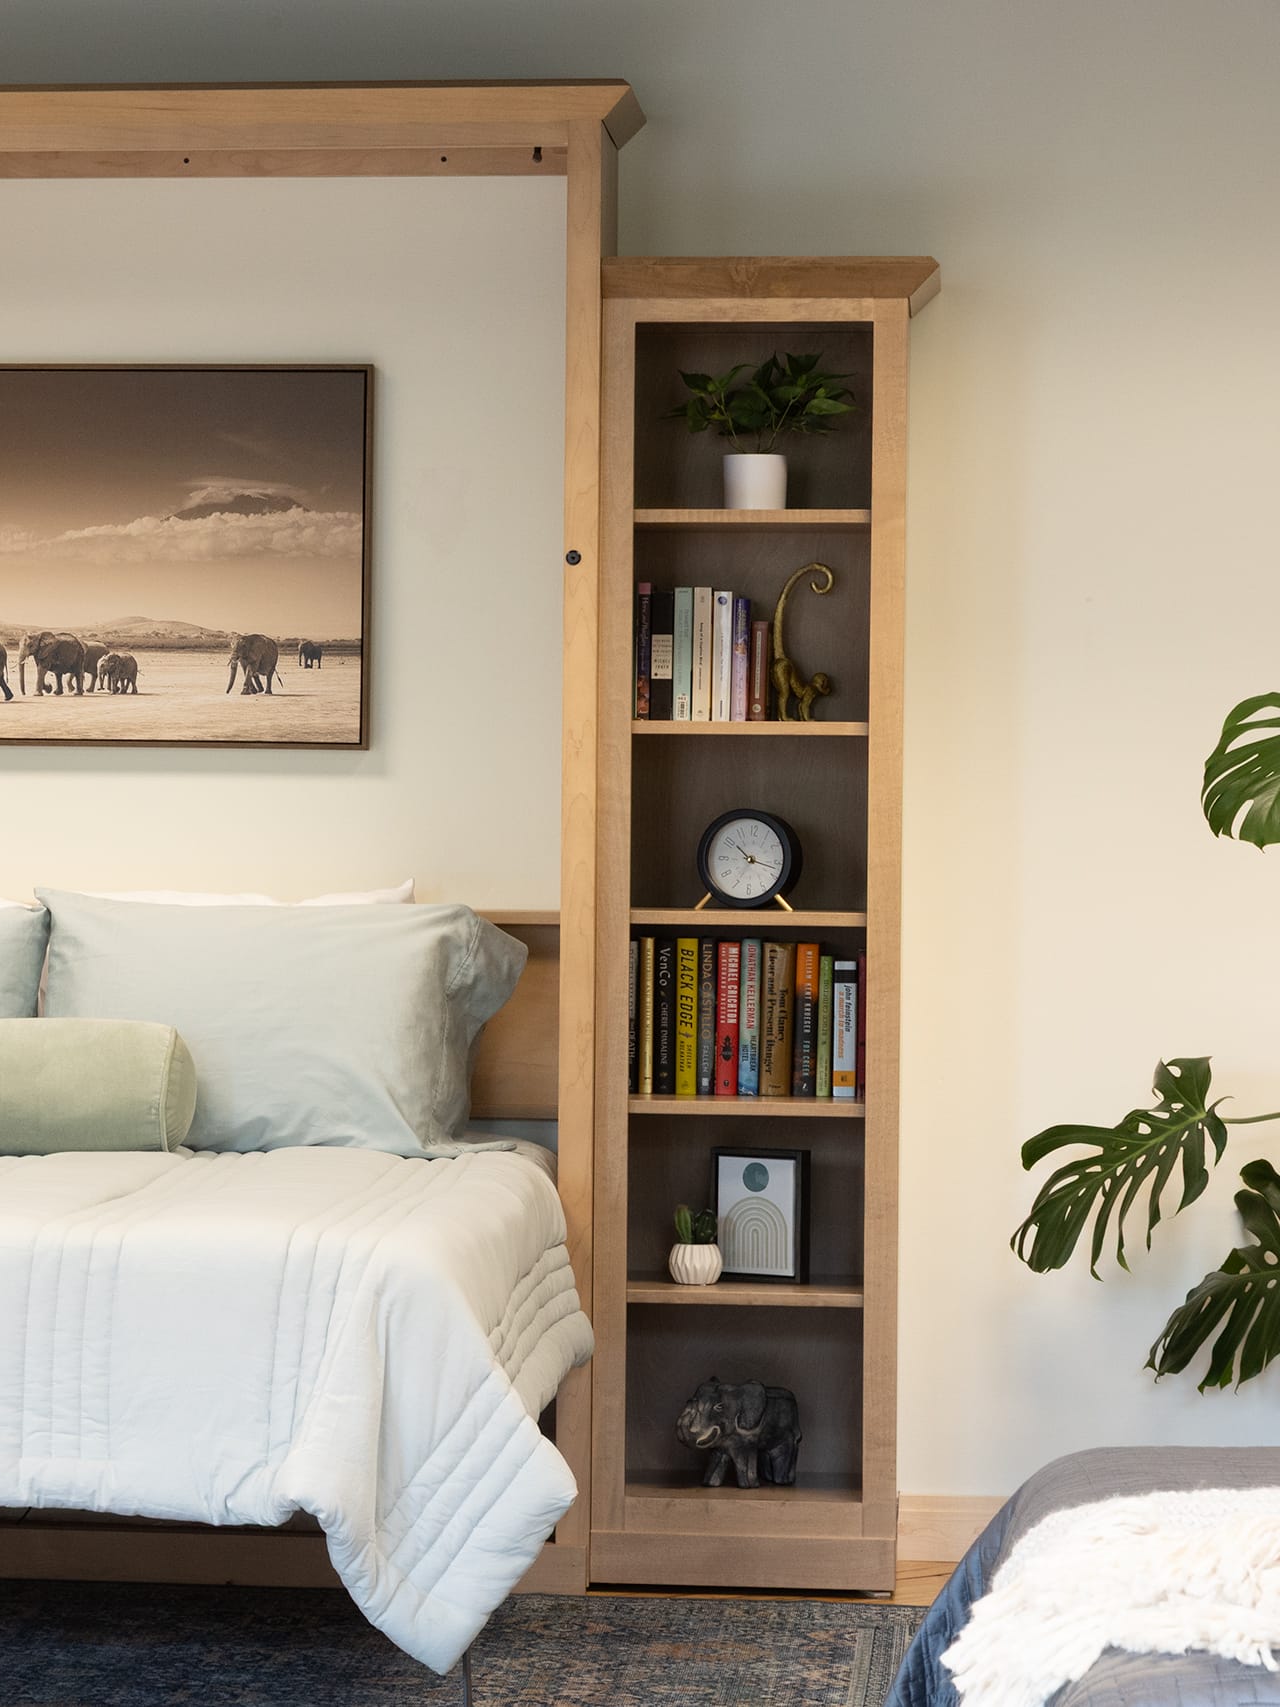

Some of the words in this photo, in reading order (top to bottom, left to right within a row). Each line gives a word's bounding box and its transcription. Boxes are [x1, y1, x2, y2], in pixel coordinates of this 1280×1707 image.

[723, 836, 736, 849] 10
[736, 827, 746, 840] 11
[751, 824, 759, 838] 12
[720, 869, 732, 878] 8
[732, 879, 741, 889] 7
[746, 883, 752, 896] 6
[659, 948, 671, 987] VenCo
[680, 947, 695, 991] BLACK
[703, 943, 713, 978] LINDA
[727, 947, 739, 982] MICHAEL
[747, 943, 757, 982] JONATHAN
[768, 949, 778, 977] Clear
[805, 950, 813, 979] WILLIAM
[768, 978, 777, 995] and
[778, 987, 789, 1007] Tom
[804, 982, 812, 1000] KENT
[844, 984, 854, 999] john
[660, 1001, 669, 1027] CHERIE
[679, 994, 693, 1029] EDGE
[701, 981, 712, 1041] CASTILLO
[726, 984, 737, 1025] CRICHTON
[746, 984, 756, 1029] KELLERMAN
[767, 998, 777, 1036] Present
[803, 1002, 812, 1033] KRUEGER
[844, 1002, 853, 1033] feinstein
[775, 1009, 788, 1043] Clancy
[660, 1029, 669, 1064] DIMALINE
[741, 1043, 749, 1062] HOTEL
[749, 1034, 757, 1072] HEARTBREAK
[764, 1039, 776, 1075] Danger
[803, 1039, 811, 1053] FOX
[837, 1029, 845, 1058] madness
[701, 1044, 710, 1073] FALLEN
[802, 1055, 810, 1077] CREEK
